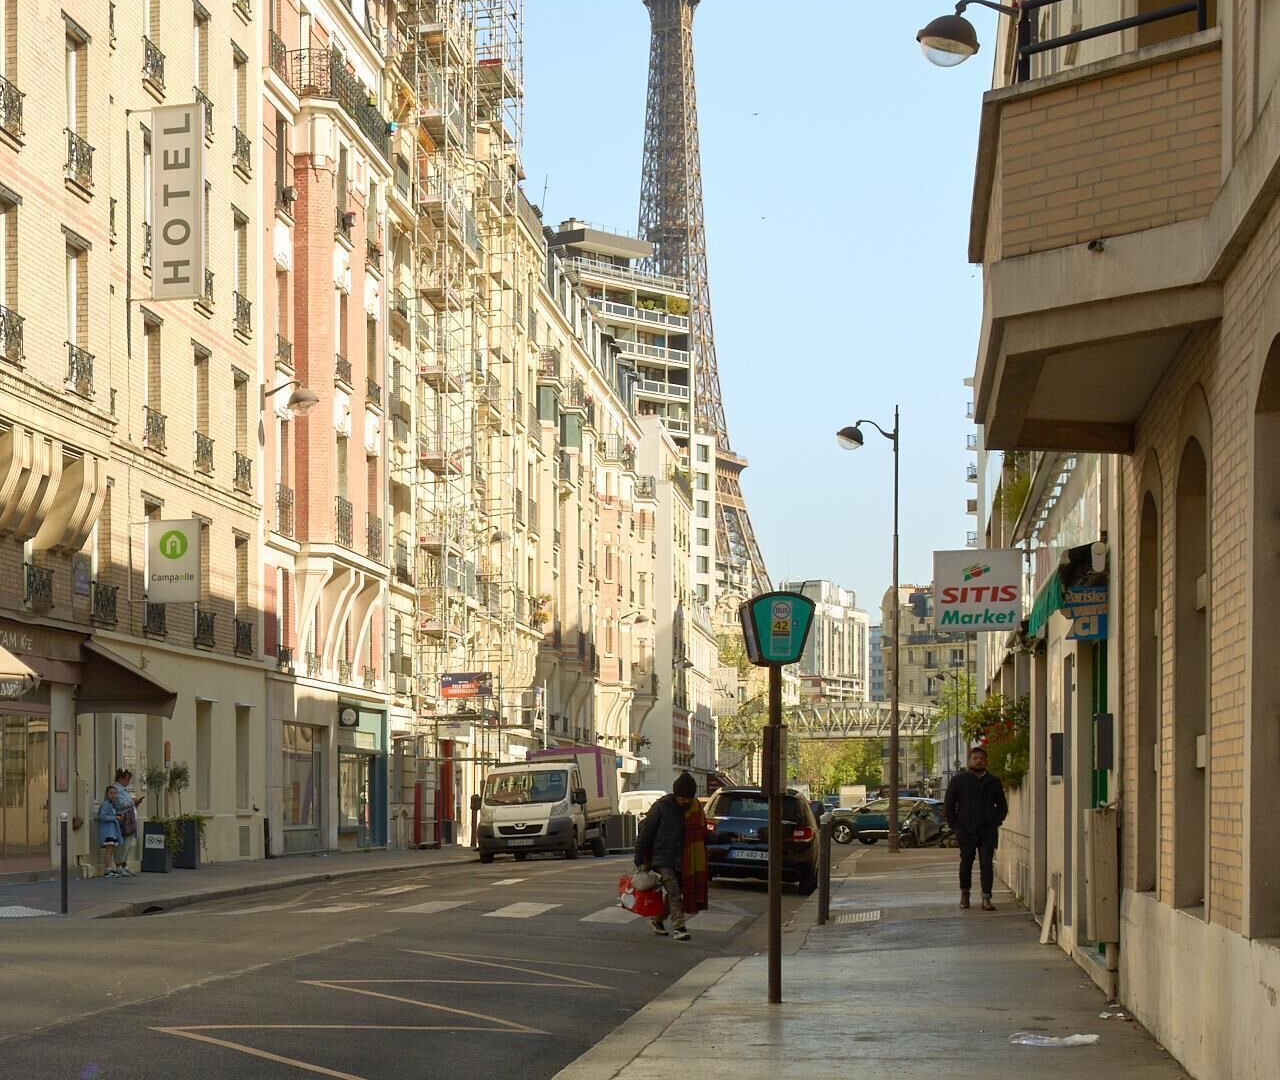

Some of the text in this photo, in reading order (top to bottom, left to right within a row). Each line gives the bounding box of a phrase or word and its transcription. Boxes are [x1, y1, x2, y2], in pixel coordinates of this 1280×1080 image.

[163, 113, 190, 284] HOTEL
[151, 572, 195, 583] Campanile
[941, 585, 1018, 604] SITIS
[775, 606, 789, 614] BUS
[941, 608, 1017, 625] Market
[774, 621, 788, 631] 42
